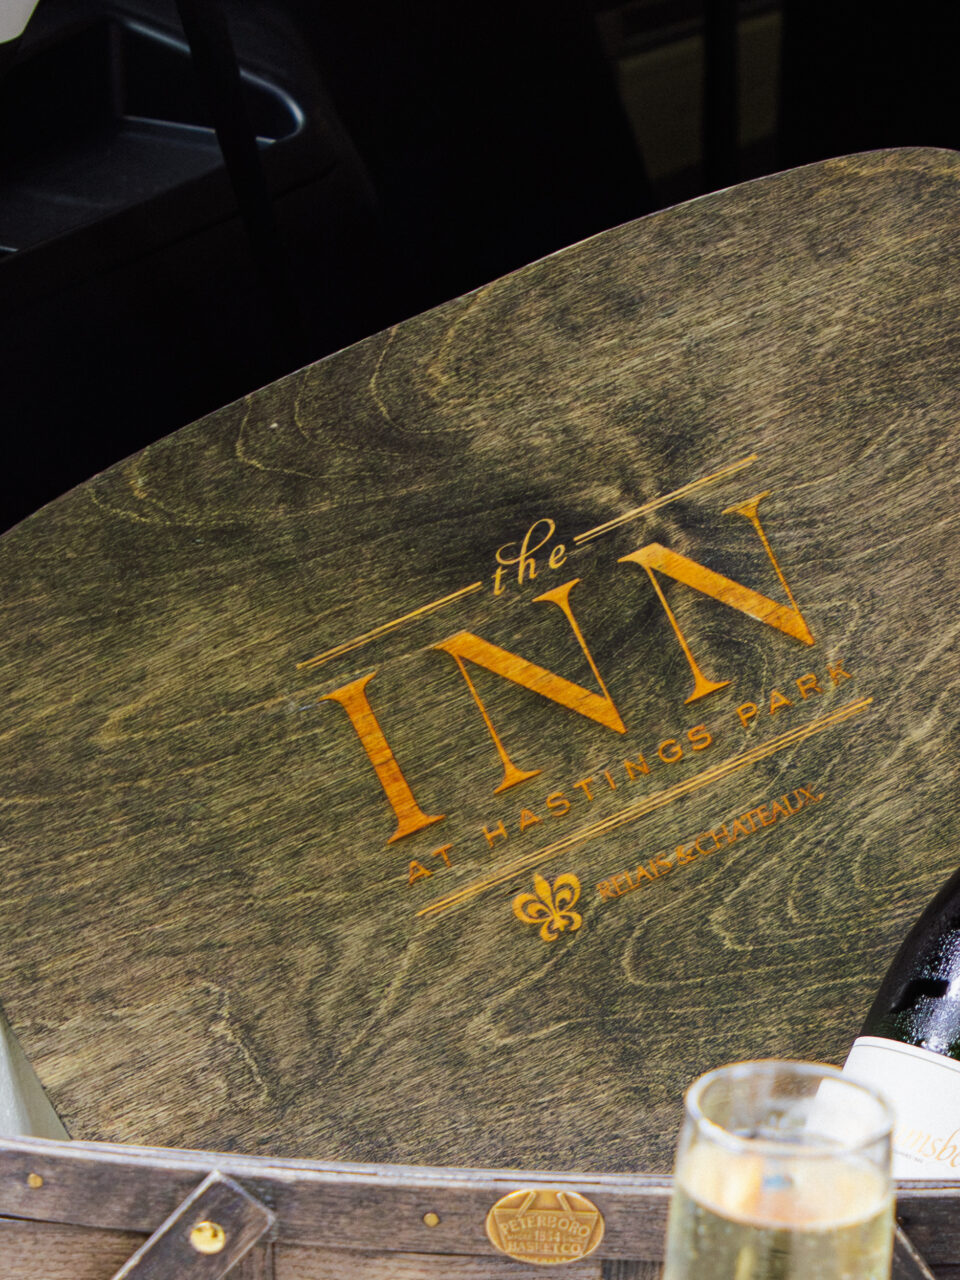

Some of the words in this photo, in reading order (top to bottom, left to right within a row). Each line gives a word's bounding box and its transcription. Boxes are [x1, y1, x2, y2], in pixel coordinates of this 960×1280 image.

[493, 517, 568, 596] the
[318, 489, 815, 844] INN
[407, 842, 453, 885] AT
[481, 723, 713, 848] HASTINGS
[736, 658, 853, 729] PARK
[596, 852, 673, 900] RELAIS
[675, 844, 697, 866] &
